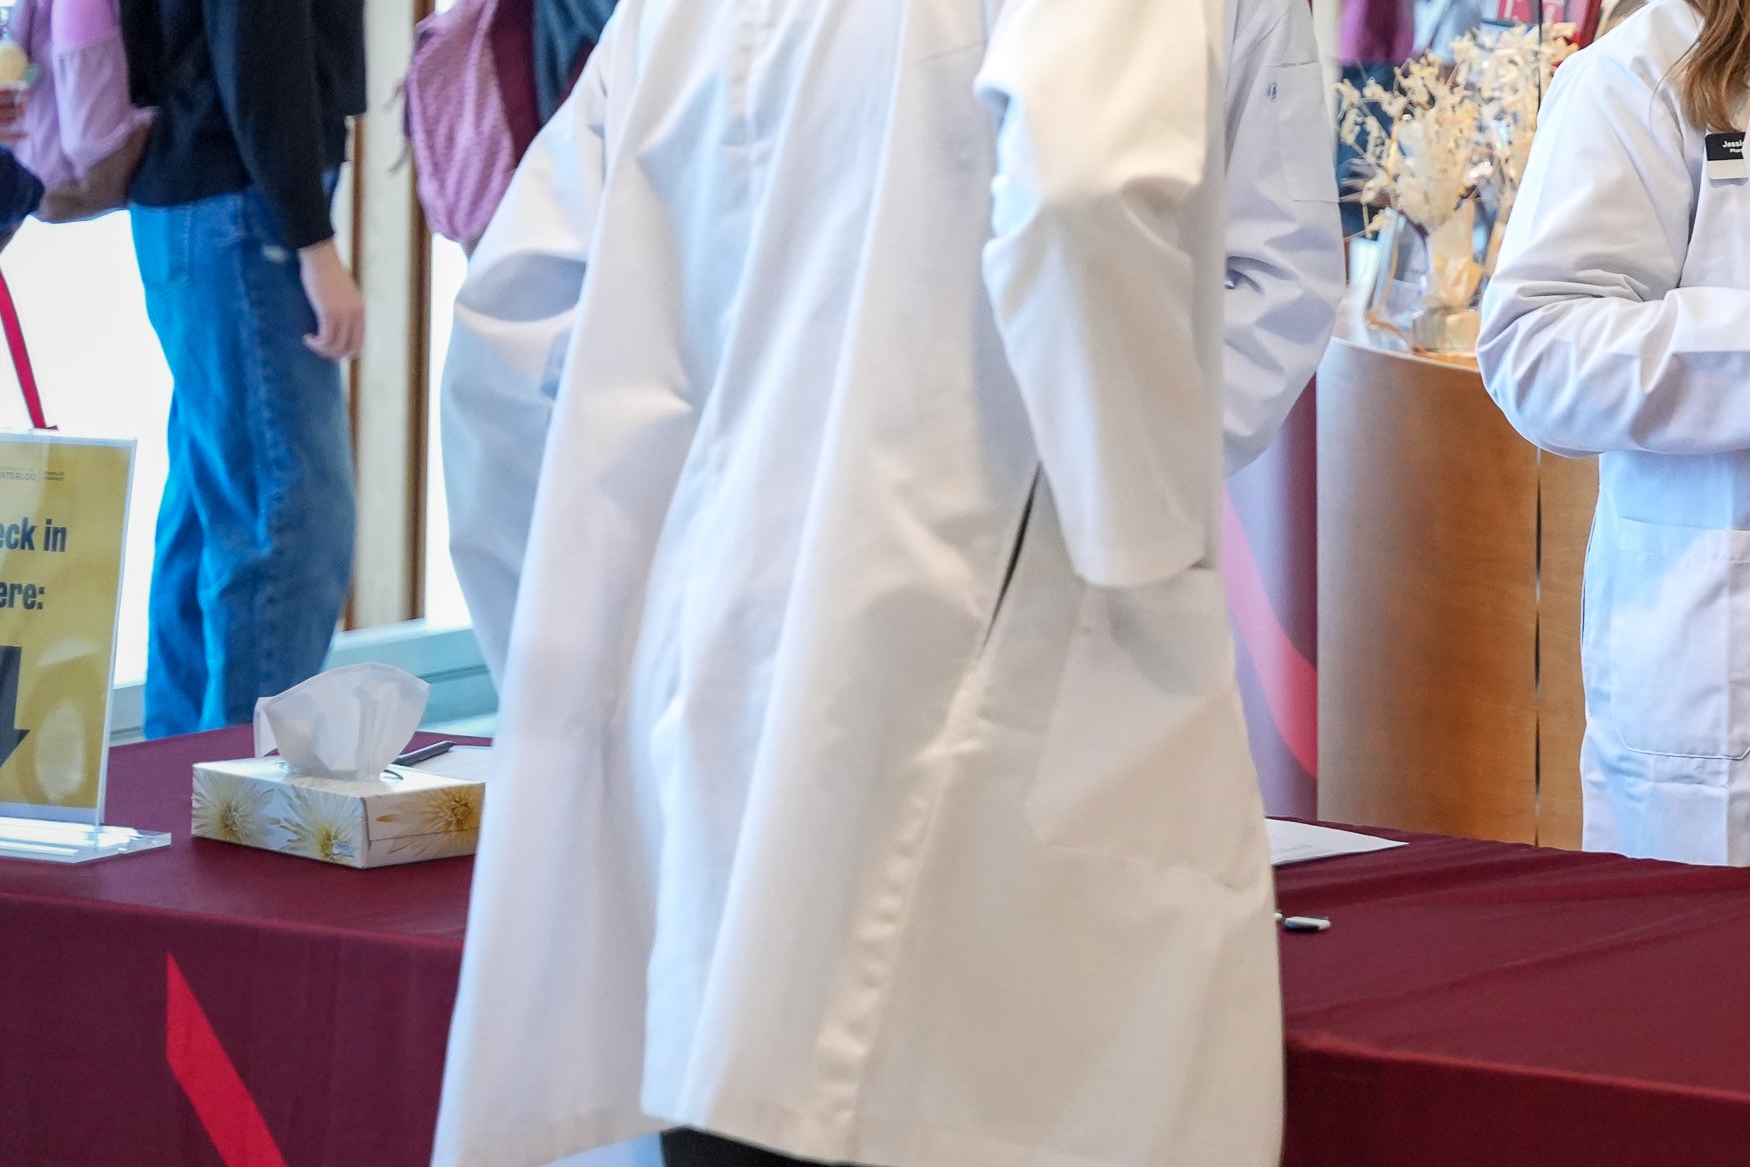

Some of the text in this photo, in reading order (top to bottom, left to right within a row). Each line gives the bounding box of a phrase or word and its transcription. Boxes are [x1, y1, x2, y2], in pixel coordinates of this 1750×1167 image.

[1722, 139, 1744, 148] Jessi
[0, 517, 68, 552] ck in
